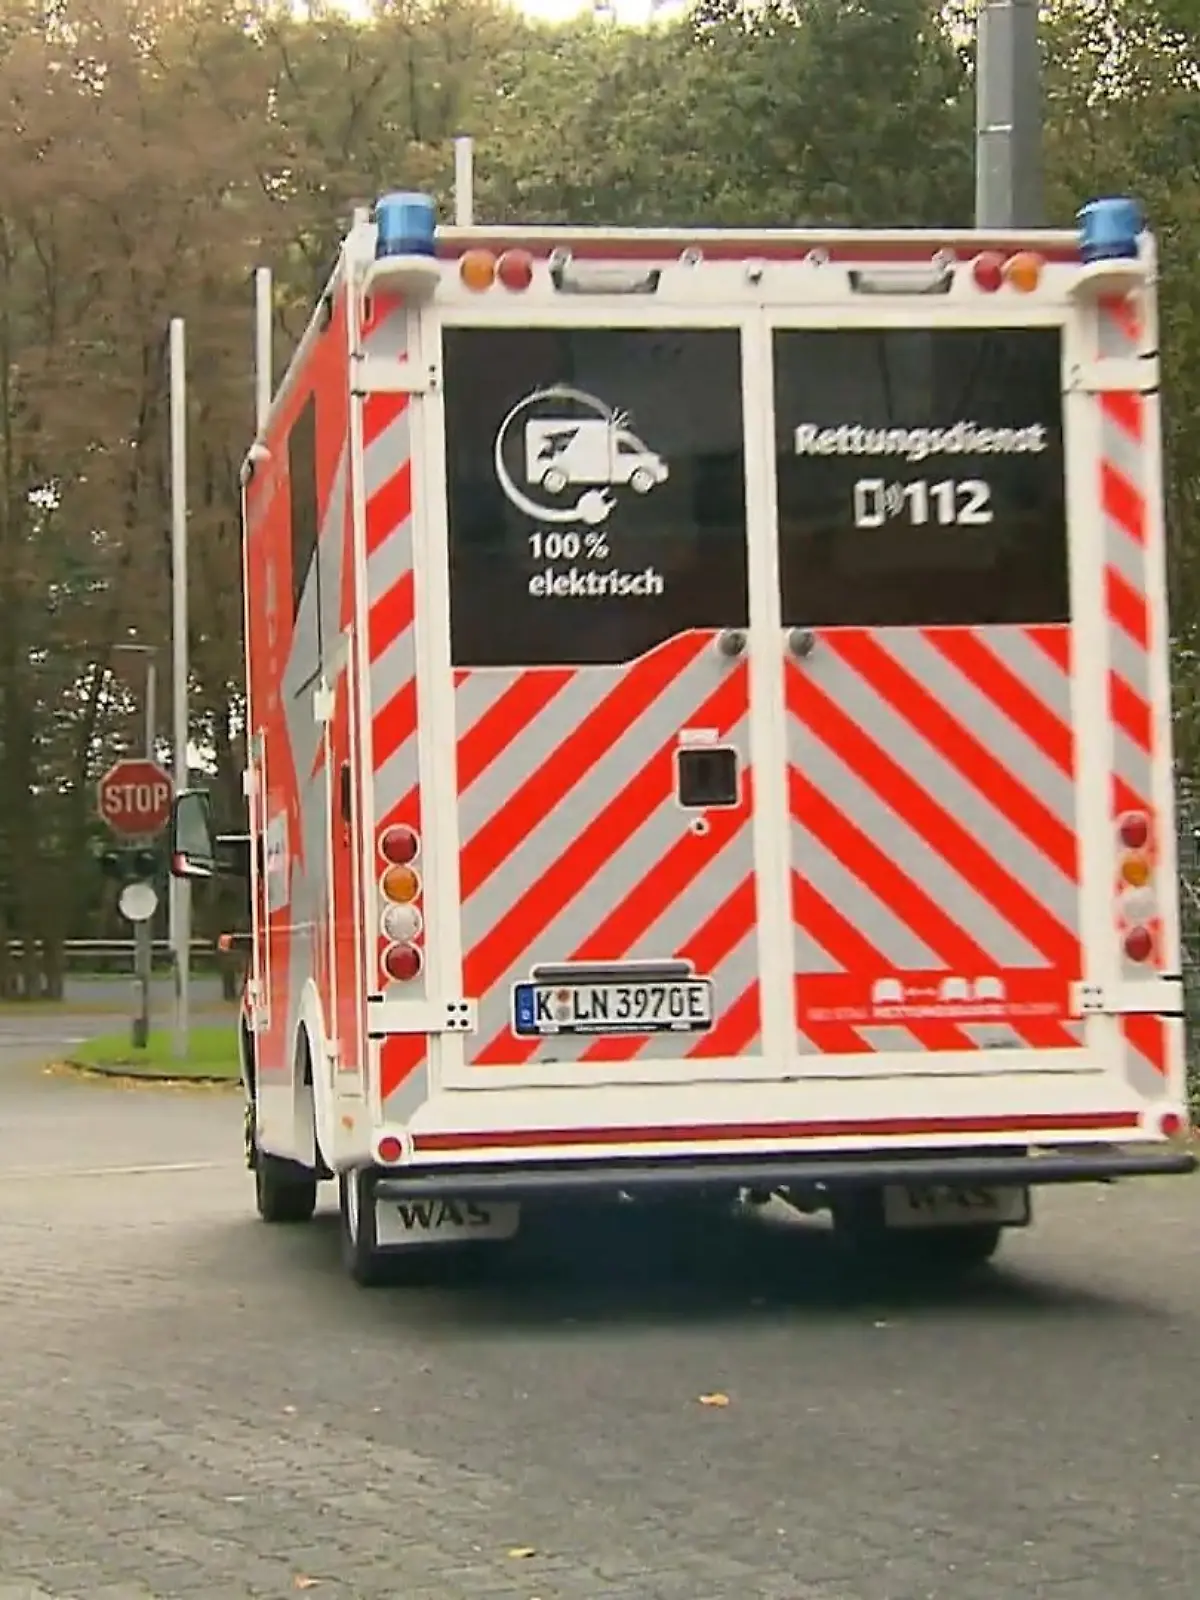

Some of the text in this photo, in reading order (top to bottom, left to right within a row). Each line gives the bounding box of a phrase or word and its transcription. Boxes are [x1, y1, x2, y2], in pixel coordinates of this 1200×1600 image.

[794, 419, 1048, 462] Rettungsdienst
[904, 479, 994, 526] 112
[528, 531, 610, 560] 100 %
[528, 566, 665, 597] elektrisch
[104, 782, 169, 814] STOP
[536, 992, 554, 1021] K
[573, 989, 609, 1019] LN
[397, 1199, 491, 1230] WAS
